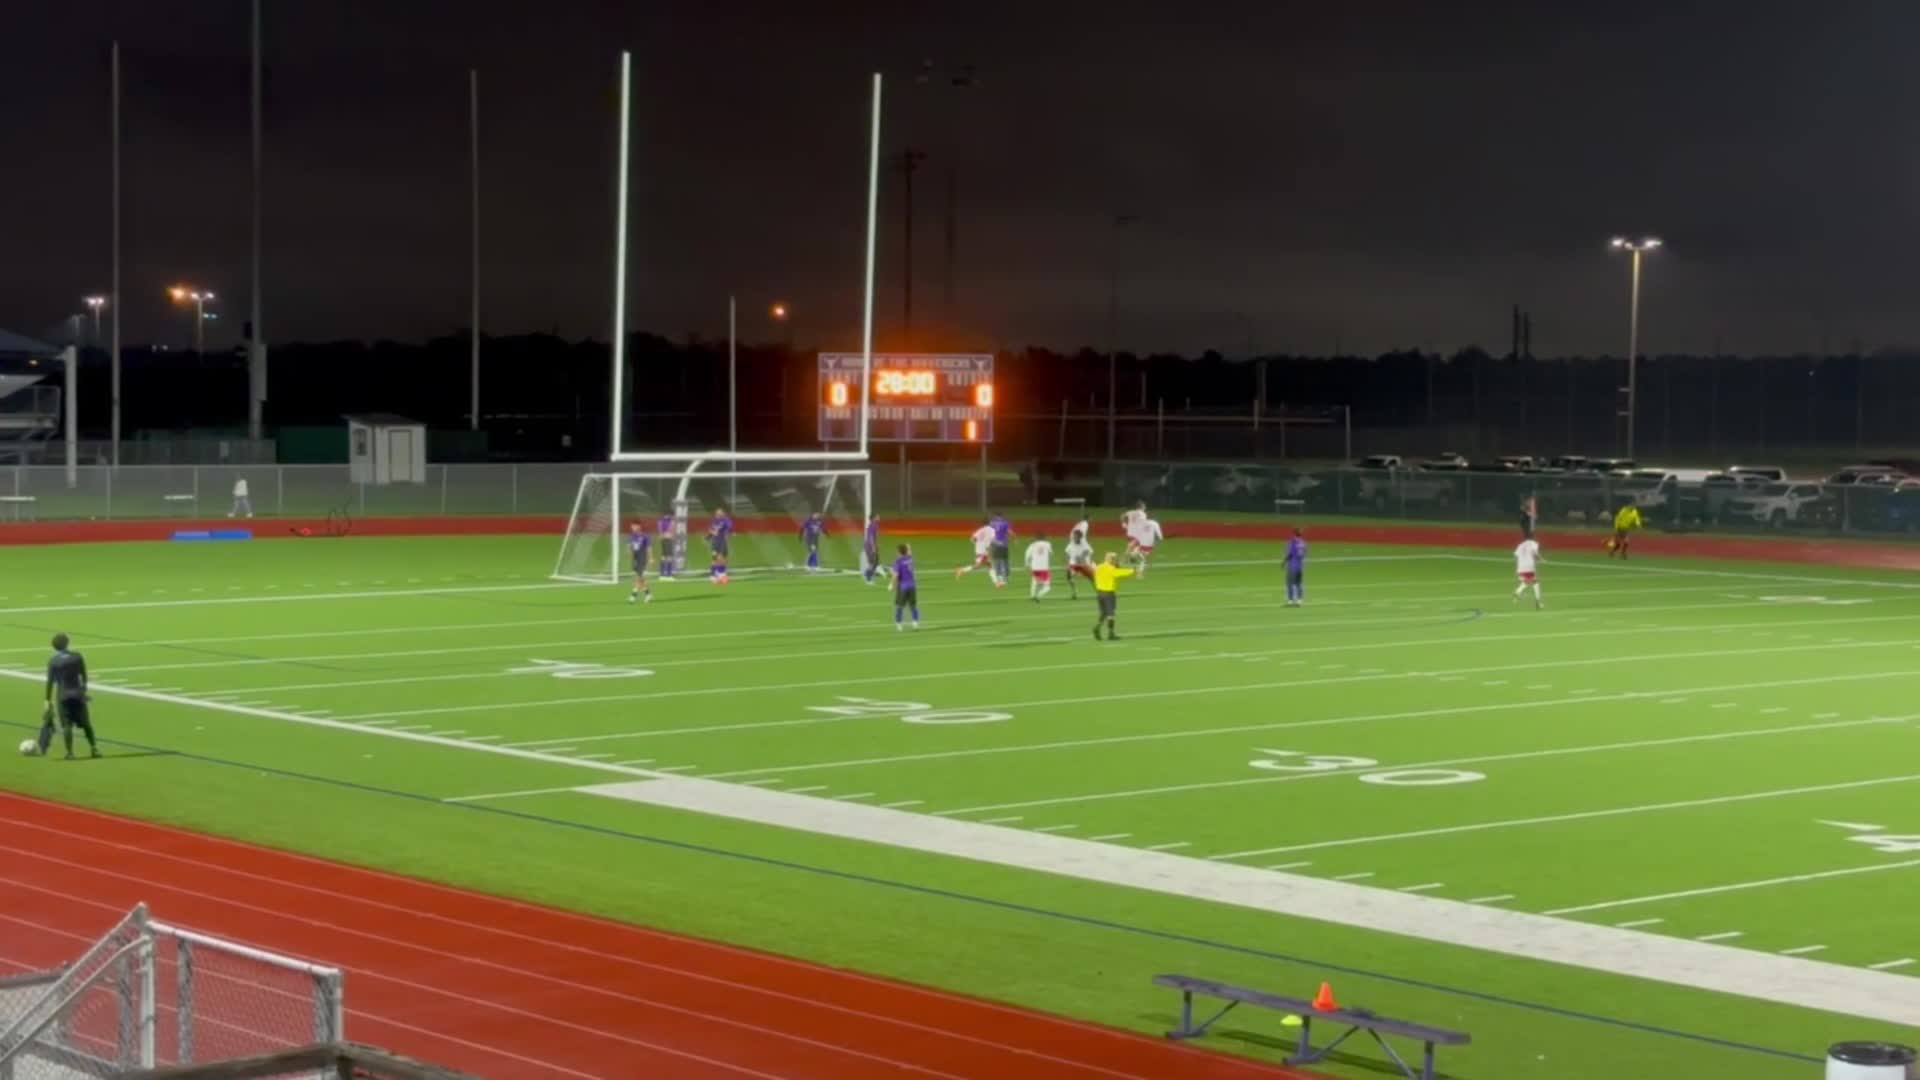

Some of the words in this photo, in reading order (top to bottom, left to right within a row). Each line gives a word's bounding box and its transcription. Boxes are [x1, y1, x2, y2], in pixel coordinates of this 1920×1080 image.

[831, 383, 847, 405] 0
[976, 384, 993, 405] 0
[967, 420, 977, 439] 1
[803, 701, 1014, 724] 20
[1248, 755, 1487, 785] 30
